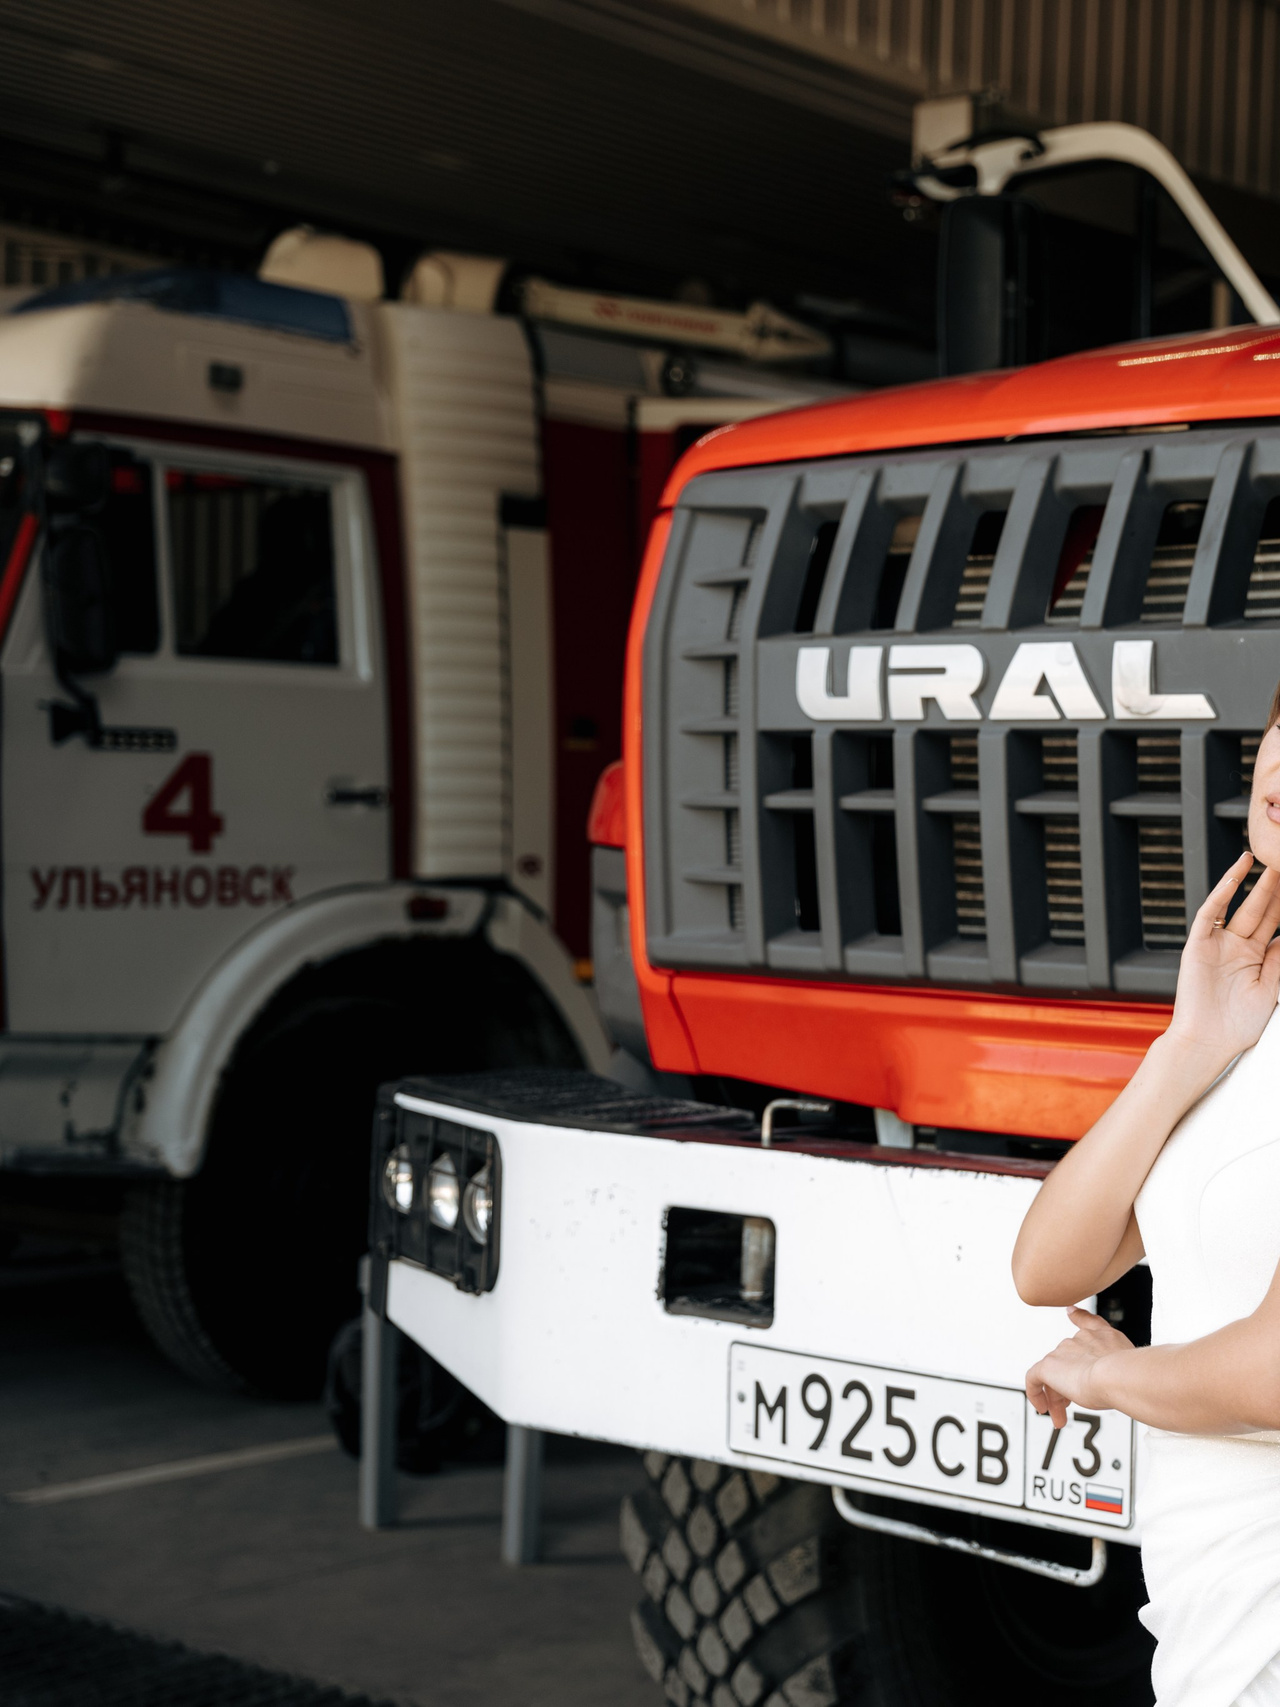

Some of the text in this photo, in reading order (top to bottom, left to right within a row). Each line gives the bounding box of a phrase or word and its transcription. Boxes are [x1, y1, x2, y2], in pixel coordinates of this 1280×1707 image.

[796, 639, 1217, 720] URAL
[142, 750, 223, 855] 4
[30, 865, 296, 911] УЛЬЯНОВСК
[1033, 1475, 1082, 1505] RUS
